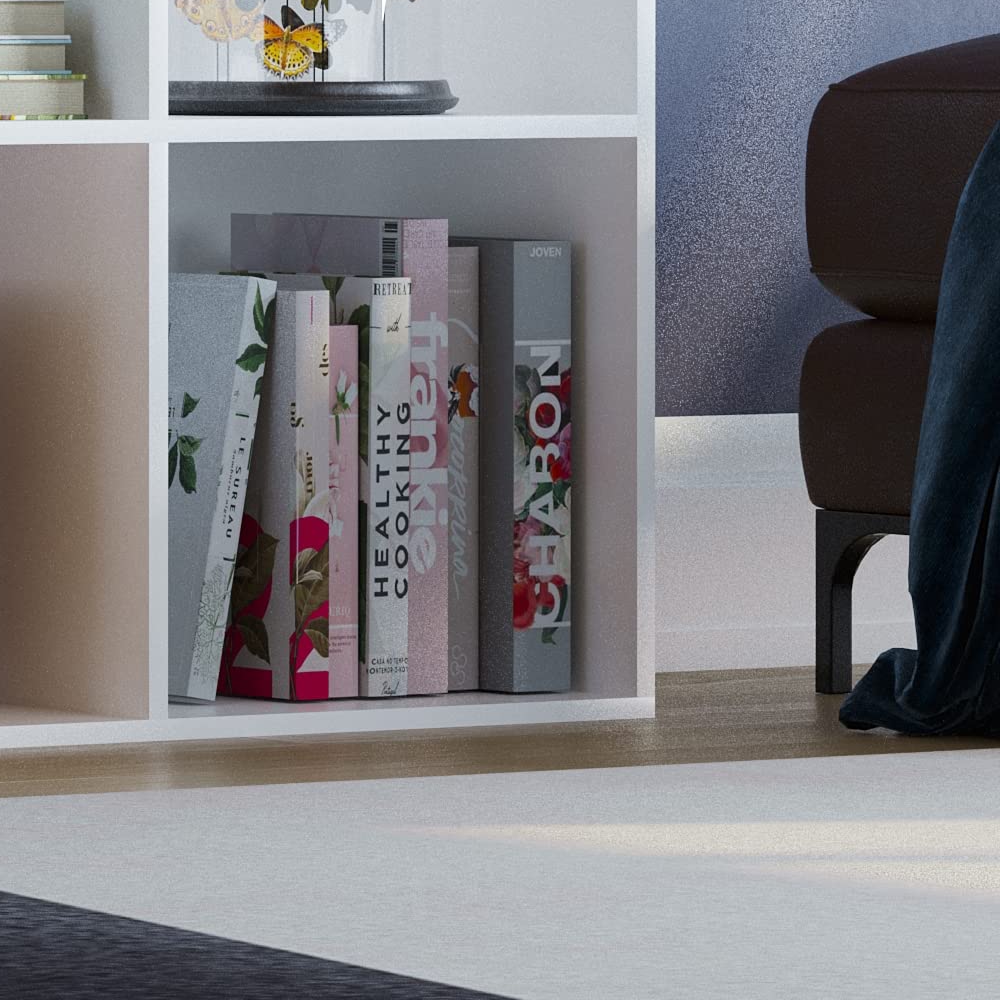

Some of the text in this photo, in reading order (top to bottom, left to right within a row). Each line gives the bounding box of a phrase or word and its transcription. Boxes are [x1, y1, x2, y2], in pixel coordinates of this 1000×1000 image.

[374, 283, 412, 295] RETREAT
[529, 247, 562, 257] JOVEN
[225, 437, 246, 538] LE SUREAU
[374, 405, 391, 597] HEALTHY
[395, 402, 411, 598] COOKING
[411, 310, 448, 574] frankie
[529, 346, 562, 628] CHABON
